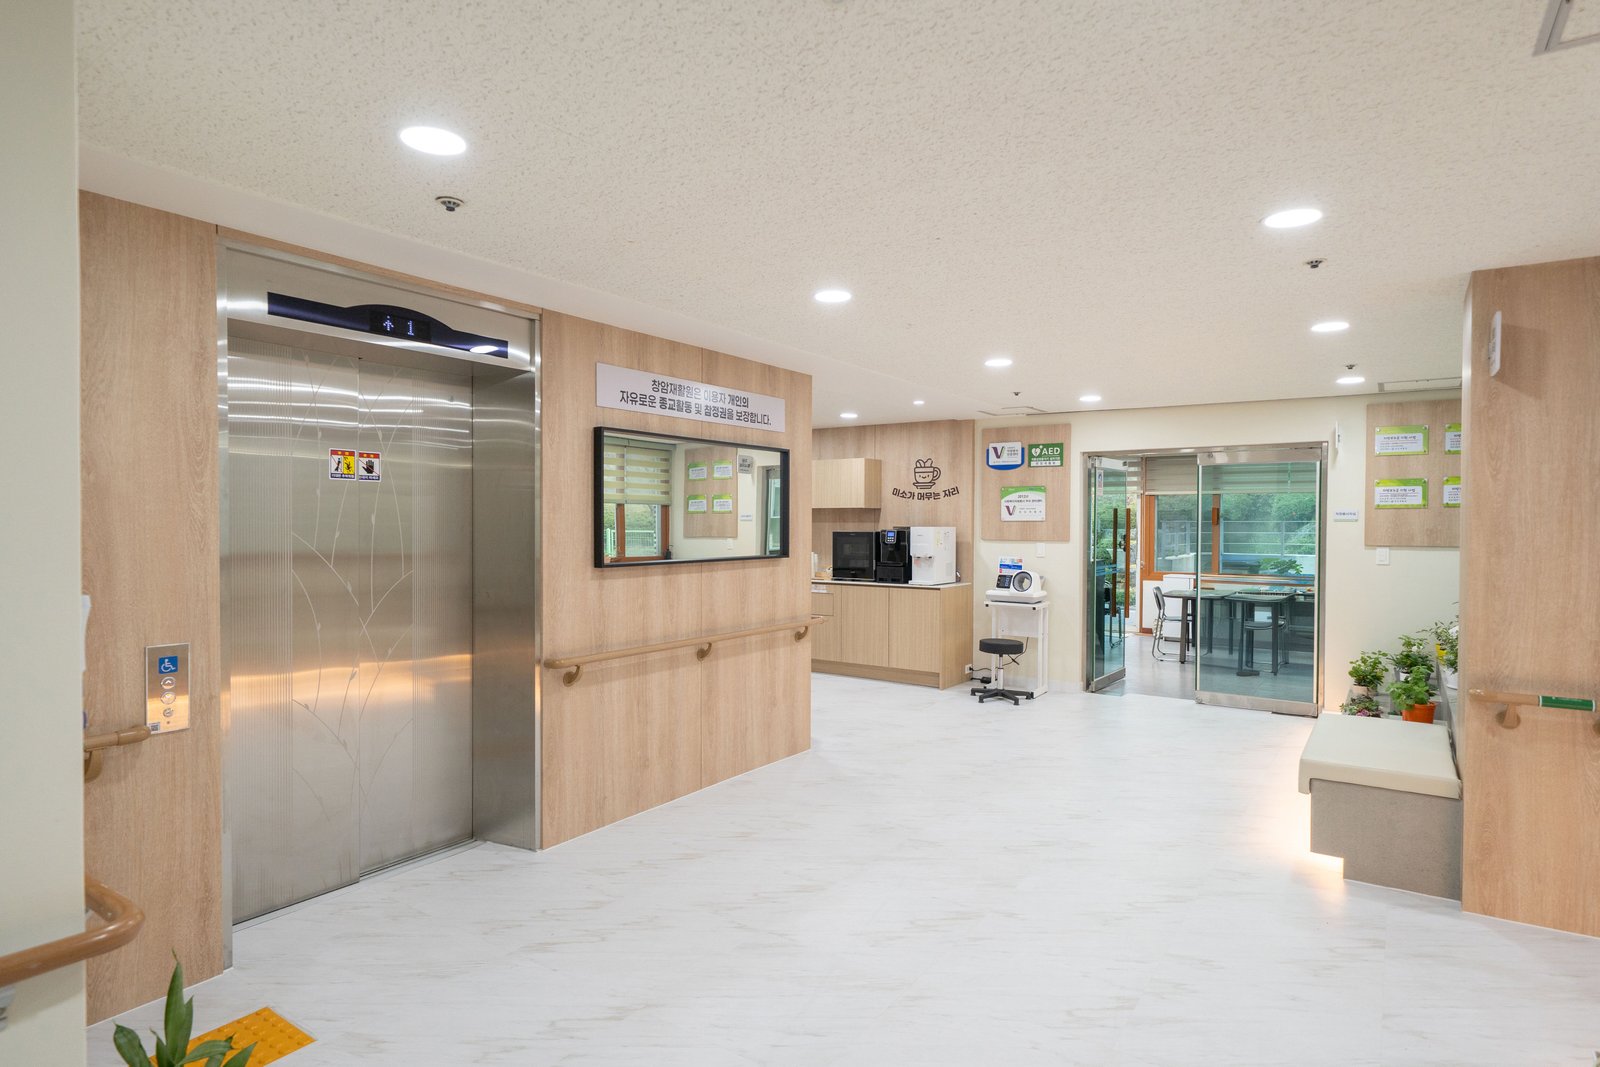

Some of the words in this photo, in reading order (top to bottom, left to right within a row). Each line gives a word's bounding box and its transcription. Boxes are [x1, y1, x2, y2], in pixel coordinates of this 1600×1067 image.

[407, 320, 414, 336] 1
[651, 379, 701, 400] 창암재활원은
[703, 389, 727, 404] 이용자
[728, 394, 749, 408] 개인의
[619, 390, 656, 408] 자유로운
[659, 396, 692, 414] 종교활동
[694, 403, 702, 415] 및
[704, 404, 734, 420] 참정권을
[735, 410, 772, 426] 보장합니다.
[1042, 447, 1060, 455] AED
[892, 487, 916, 500] 미소가
[917, 492, 941, 500] 머무는
[942, 486, 960, 498] 자리
